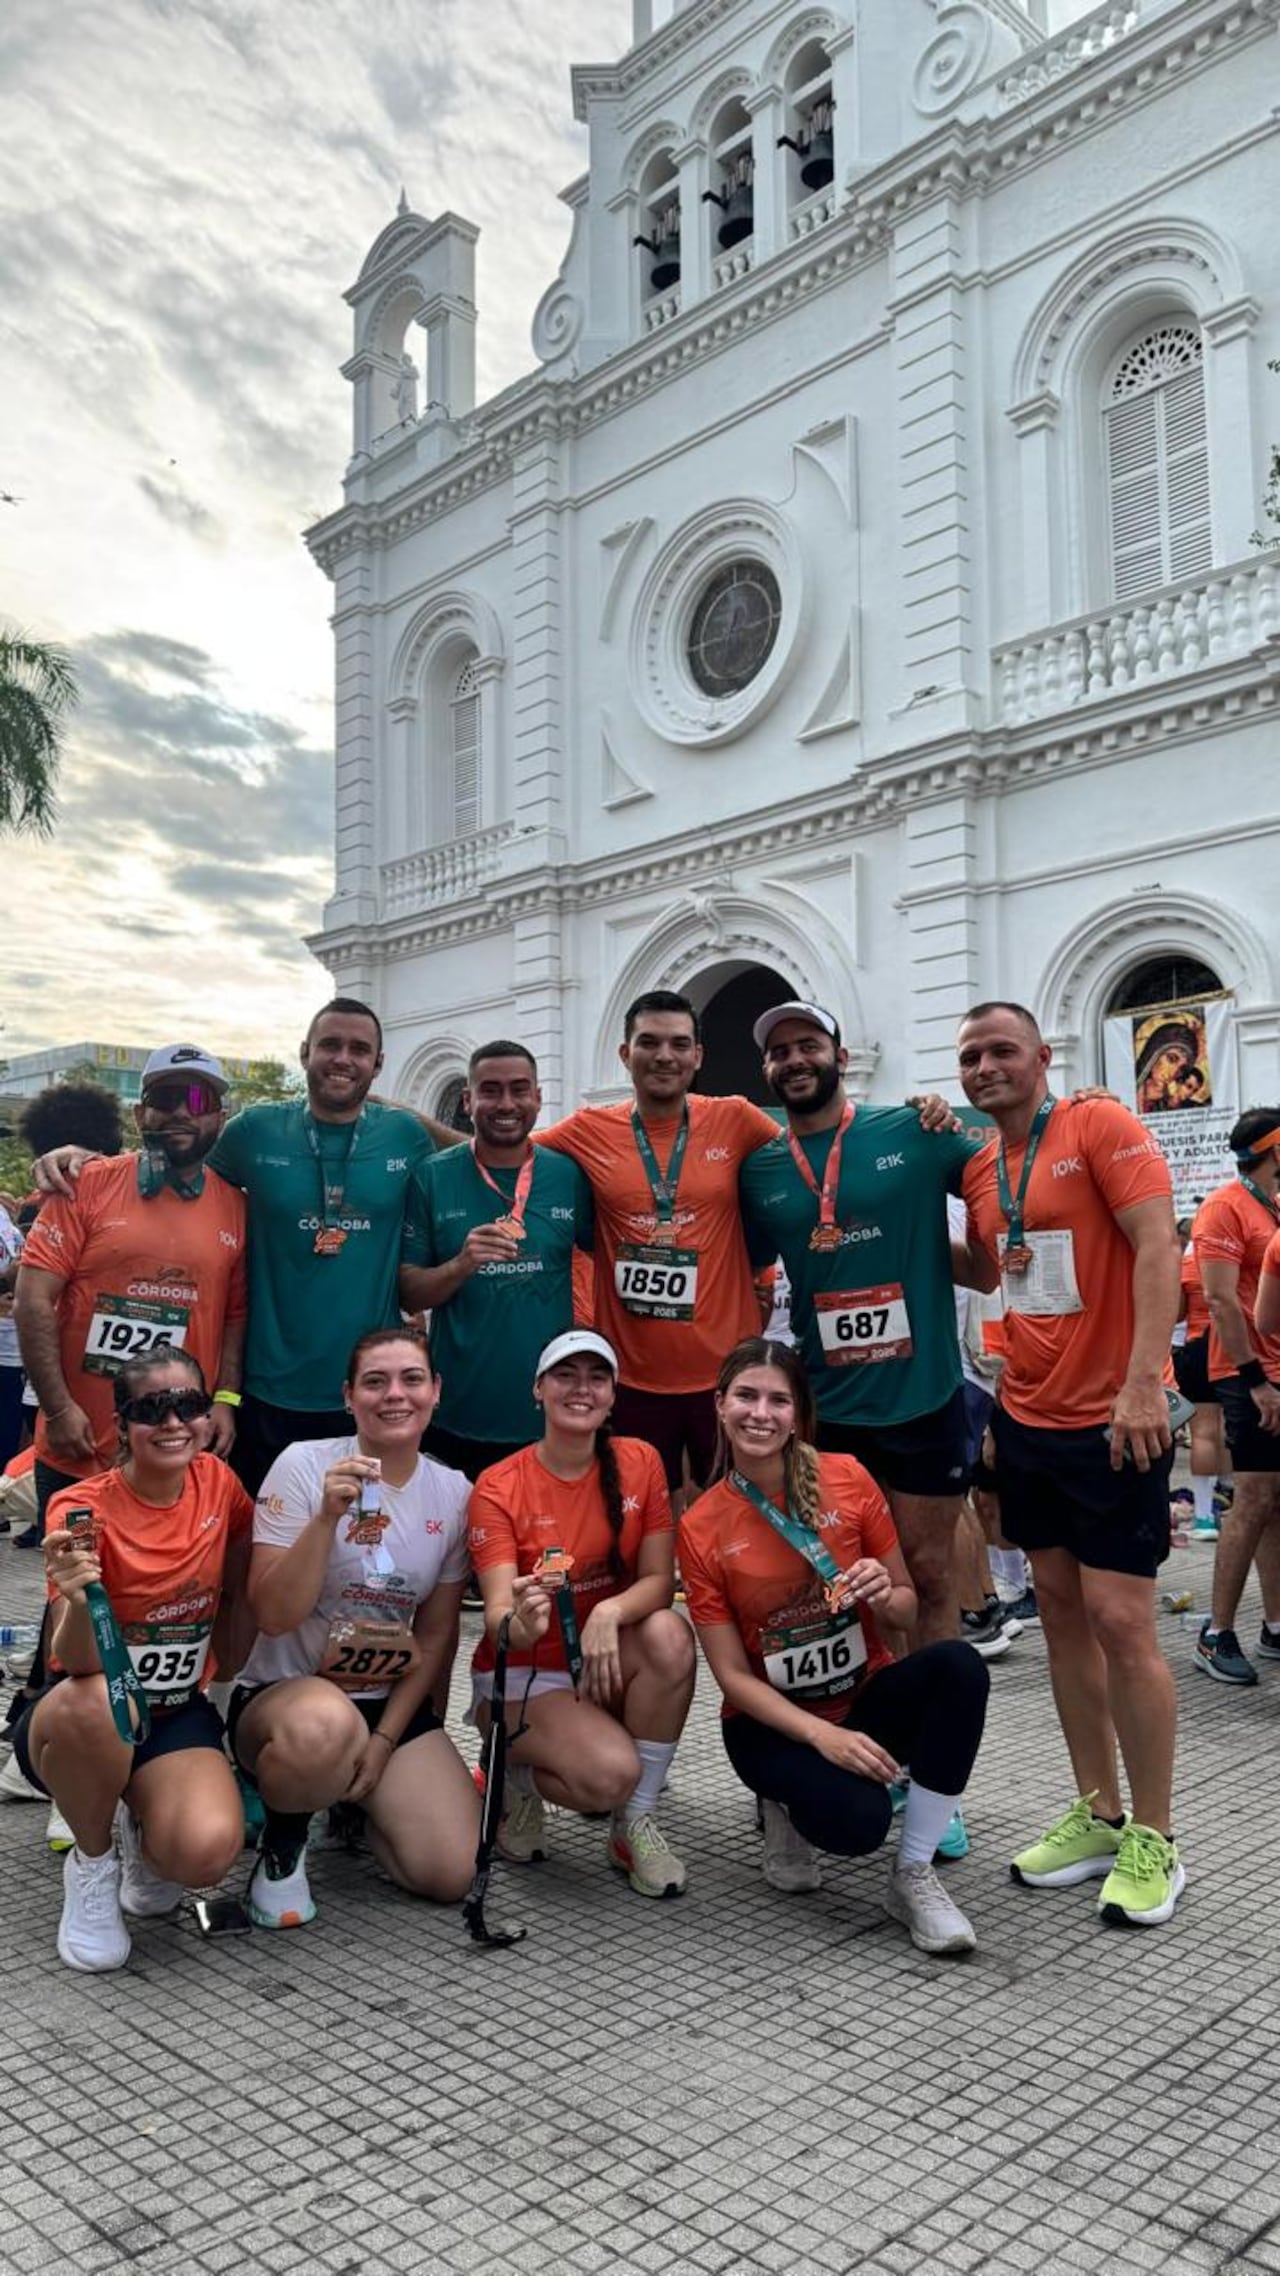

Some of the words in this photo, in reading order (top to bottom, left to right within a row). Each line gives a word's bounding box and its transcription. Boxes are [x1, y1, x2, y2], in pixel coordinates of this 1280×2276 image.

[387, 1157, 408, 1172] 21K
[705, 1147, 729, 1162] 10K
[876, 1152, 905, 1171] 21K
[1052, 1156, 1082, 1179] 10K
[551, 1207, 575, 1221] 21K
[219, 1230, 238, 1249] 10K
[621, 1266, 687, 1298] 1850
[836, 1309, 889, 1341] 687
[426, 1520, 444, 1535] 5K
[138, 1648, 200, 1683] 935
[328, 1646, 414, 1677] 2872
[782, 1637, 851, 1685] 1416
